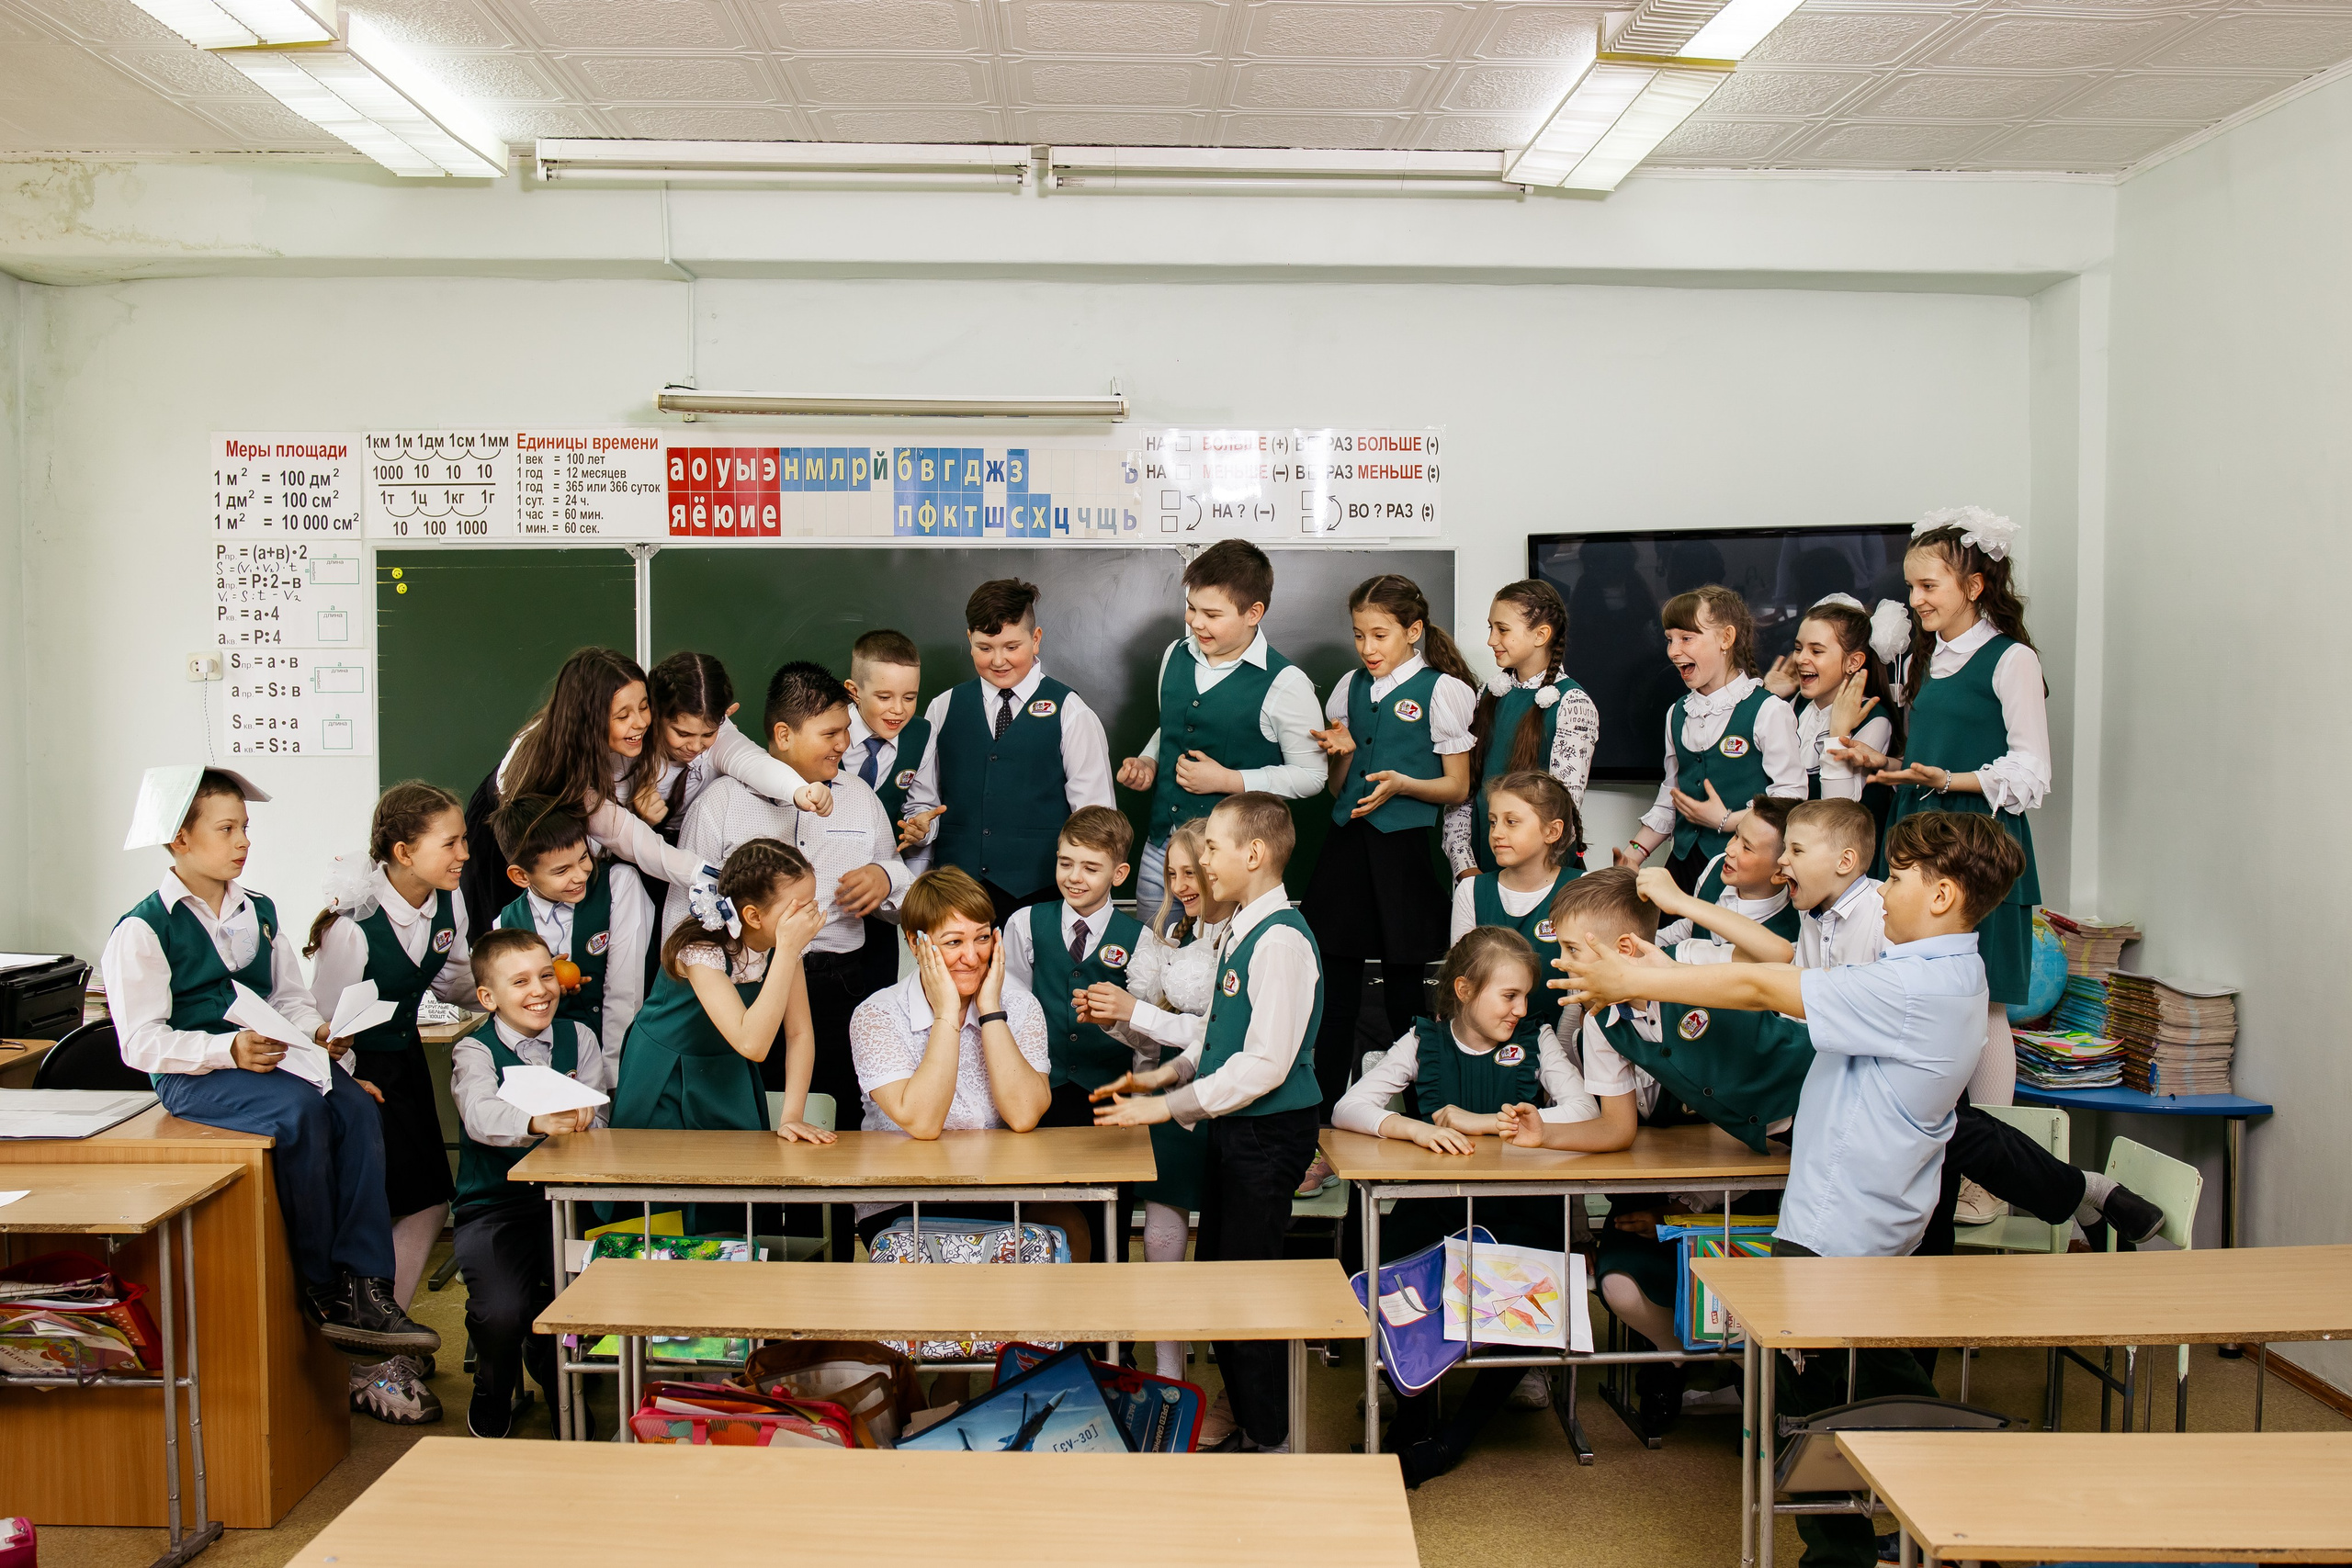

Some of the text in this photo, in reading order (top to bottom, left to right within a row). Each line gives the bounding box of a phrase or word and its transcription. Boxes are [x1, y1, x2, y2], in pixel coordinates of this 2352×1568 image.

[366, 433, 508, 452] 1км 1м 1дм 1см 1мм
[517, 434, 658, 453] Единицы времени
[1358, 437, 1421, 451] БОЛЬШЕ
[226, 440, 346, 461] Меры площади
[517, 453, 521, 464] 1
[526, 456, 543, 464] век
[567, 453, 583, 464] 100
[215, 470, 220, 485] 1
[280, 470, 304, 486] 100
[373, 464, 492, 479] 1000 10 10 10
[517, 467, 521, 478] 1
[526, 469, 543, 479] год
[567, 467, 578, 478] 12
[582, 470, 626, 479] месяцев
[1147, 465, 1167, 479] НА
[1359, 465, 1422, 479] МЕНЬШЕ
[517, 480, 521, 491] 1
[526, 483, 543, 493] год
[566, 480, 583, 491] 365
[610, 481, 628, 492] 366
[631, 484, 660, 495] суток
[215, 492, 220, 507] 1
[283, 492, 307, 507] 100
[380, 490, 494, 508] 1т 1ц 1кг 1г
[517, 494, 521, 505] 1
[526, 497, 544, 508] сут.
[565, 494, 577, 505] 24
[517, 508, 521, 519] 1
[526, 511, 543, 519] час
[565, 508, 576, 519] 60
[1213, 503, 1233, 518] НА
[1350, 503, 1369, 518] ВО
[1387, 503, 1413, 518] РАЗ
[215, 514, 220, 529] 1
[282, 514, 298, 530] 10
[303, 514, 328, 530] 000
[393, 521, 487, 536] 10 100 1000
[517, 522, 521, 533] 1
[526, 525, 548, 533] мин.
[565, 522, 576, 533] 60
[1159, 1404, 1170, 1425] SPEED
